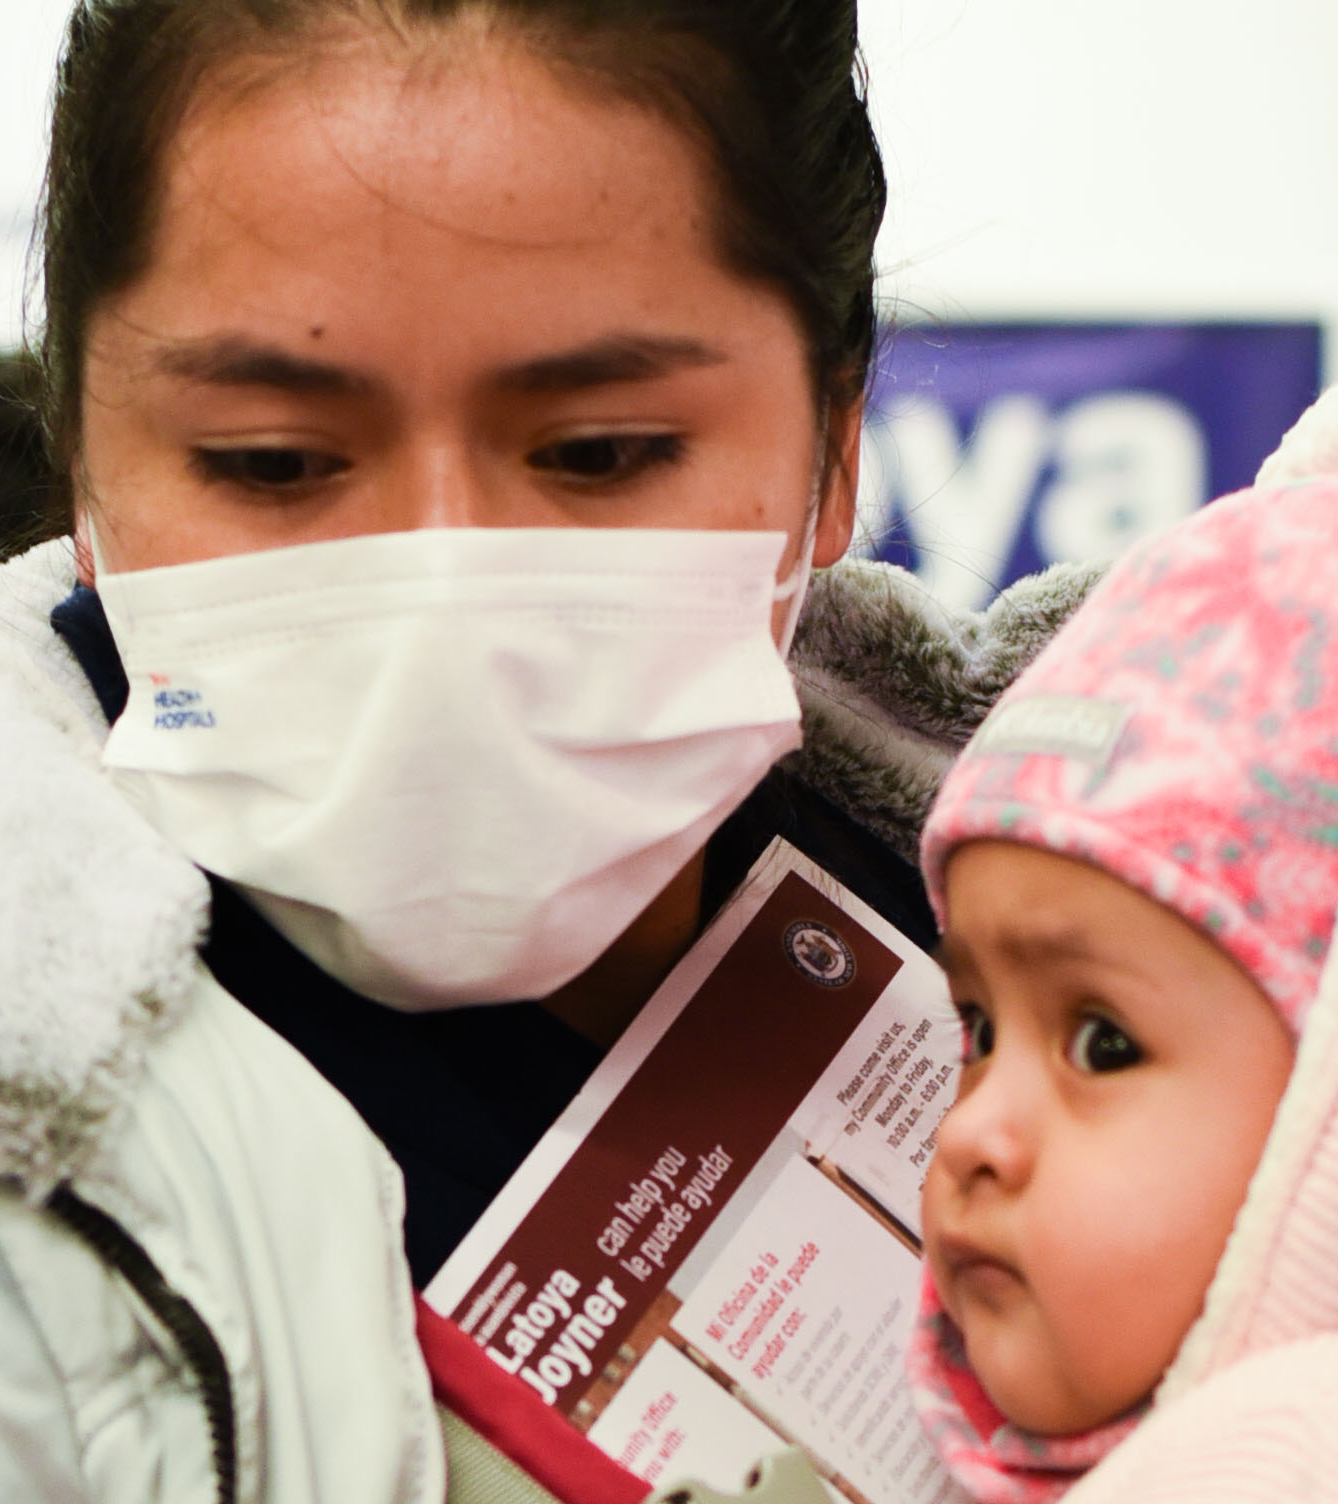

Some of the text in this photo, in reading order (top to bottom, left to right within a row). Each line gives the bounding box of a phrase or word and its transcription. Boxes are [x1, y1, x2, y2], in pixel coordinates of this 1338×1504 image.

[836, 1021, 906, 1105] Please come visit us,
[843, 1018, 932, 1135] my Community Office is open
[875, 1056, 933, 1127] Monday to Friday,
[886, 1122, 909, 1148] 10:00
[904, 1107, 923, 1126] a.m.
[920, 1079, 940, 1102] 6:00
[935, 1064, 953, 1085] p.m.
[597, 1147, 686, 1256] can help you
[909, 1148, 926, 1167] Por
[620, 1145, 732, 1280] le puede ayudar
[486, 1270, 579, 1373] Latoya
[521, 1277, 625, 1404] Joyner
[706, 1252, 779, 1341] Mi Oficina de la
[728, 1242, 819, 1360] Comunidad le puede
[752, 1308, 805, 1378] ayudar con:
[642, 1392, 676, 1429] Office
